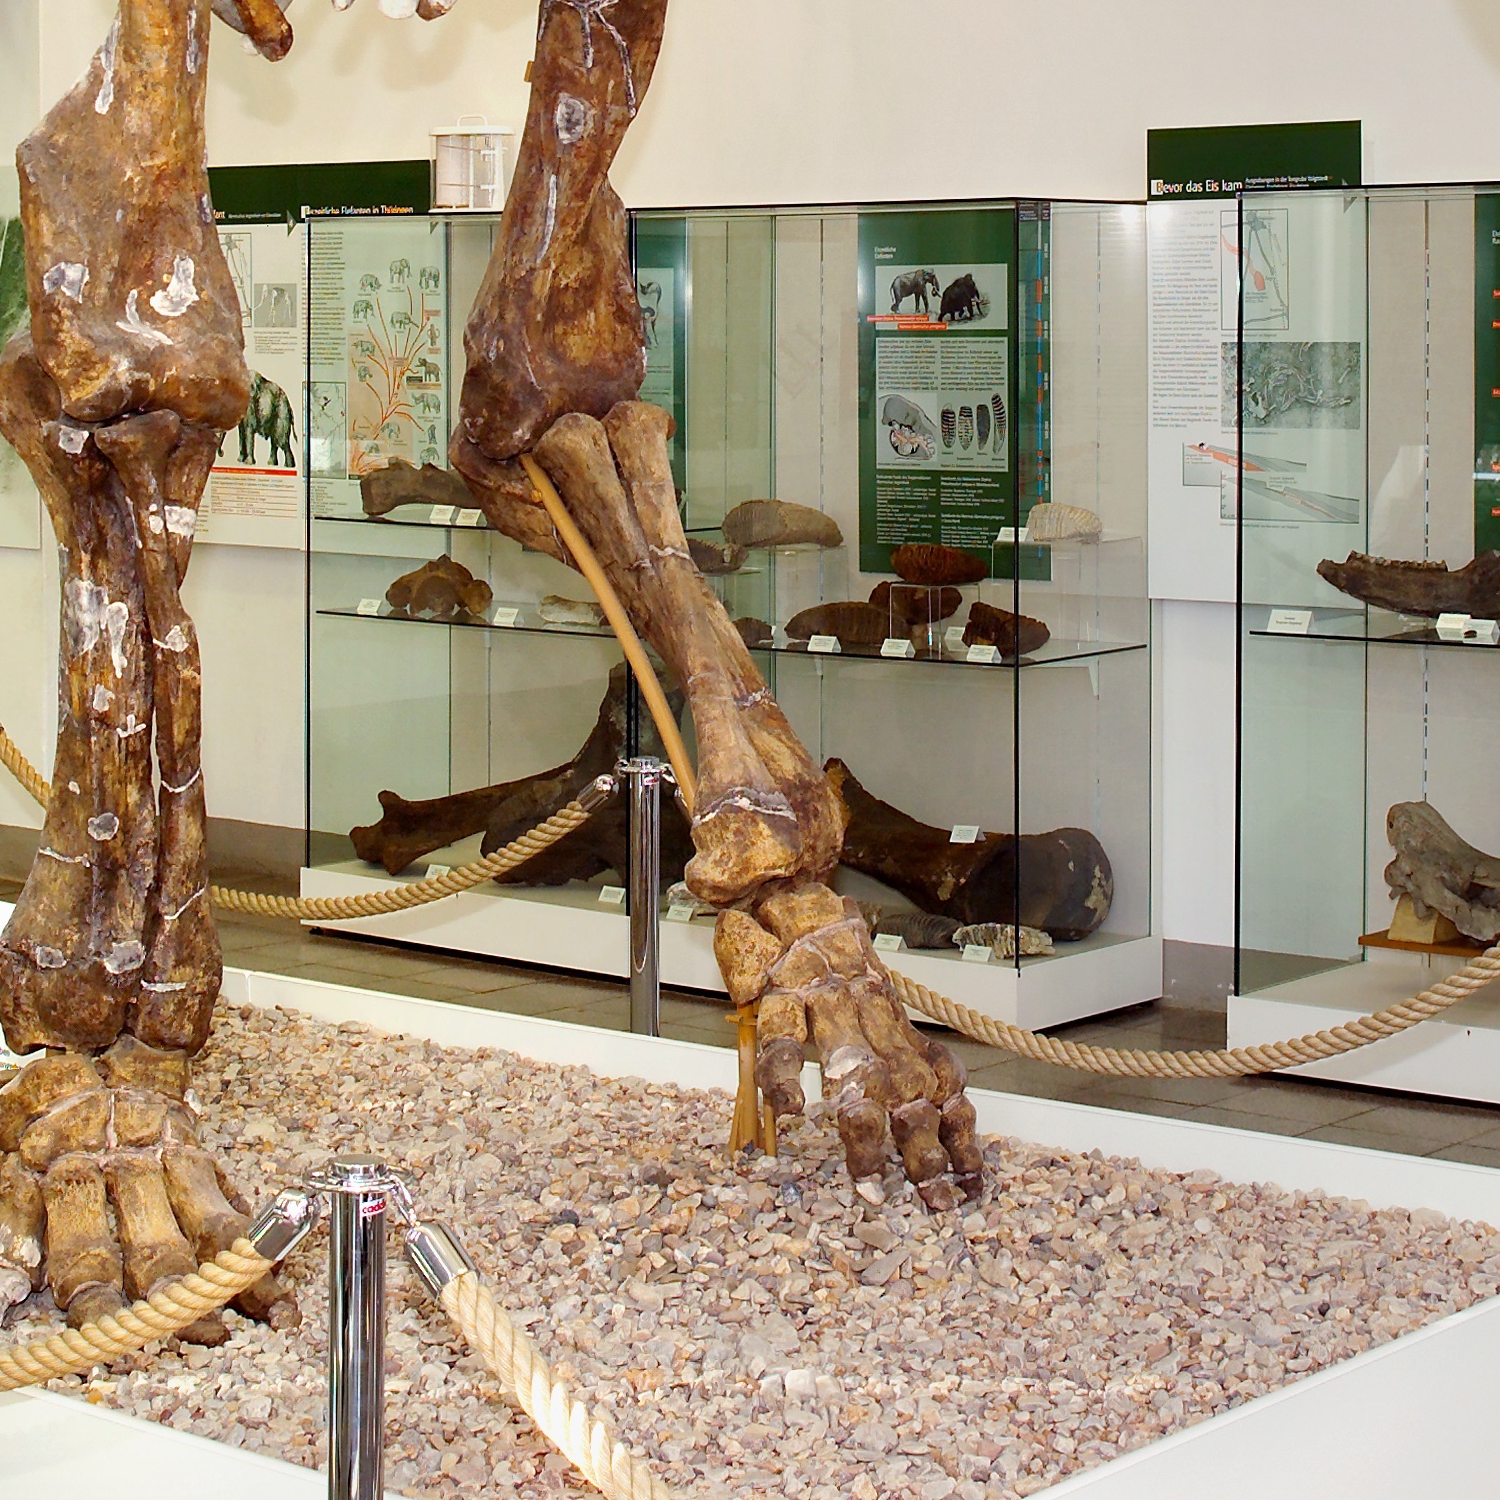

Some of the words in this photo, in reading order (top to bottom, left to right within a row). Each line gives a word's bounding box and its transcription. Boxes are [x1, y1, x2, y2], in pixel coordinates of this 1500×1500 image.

[1157, 179, 1183, 194] Bevor
[1186, 179, 1203, 193] das
[1206, 179, 1220, 192] Eis
[1222, 179, 1243, 192] kam
